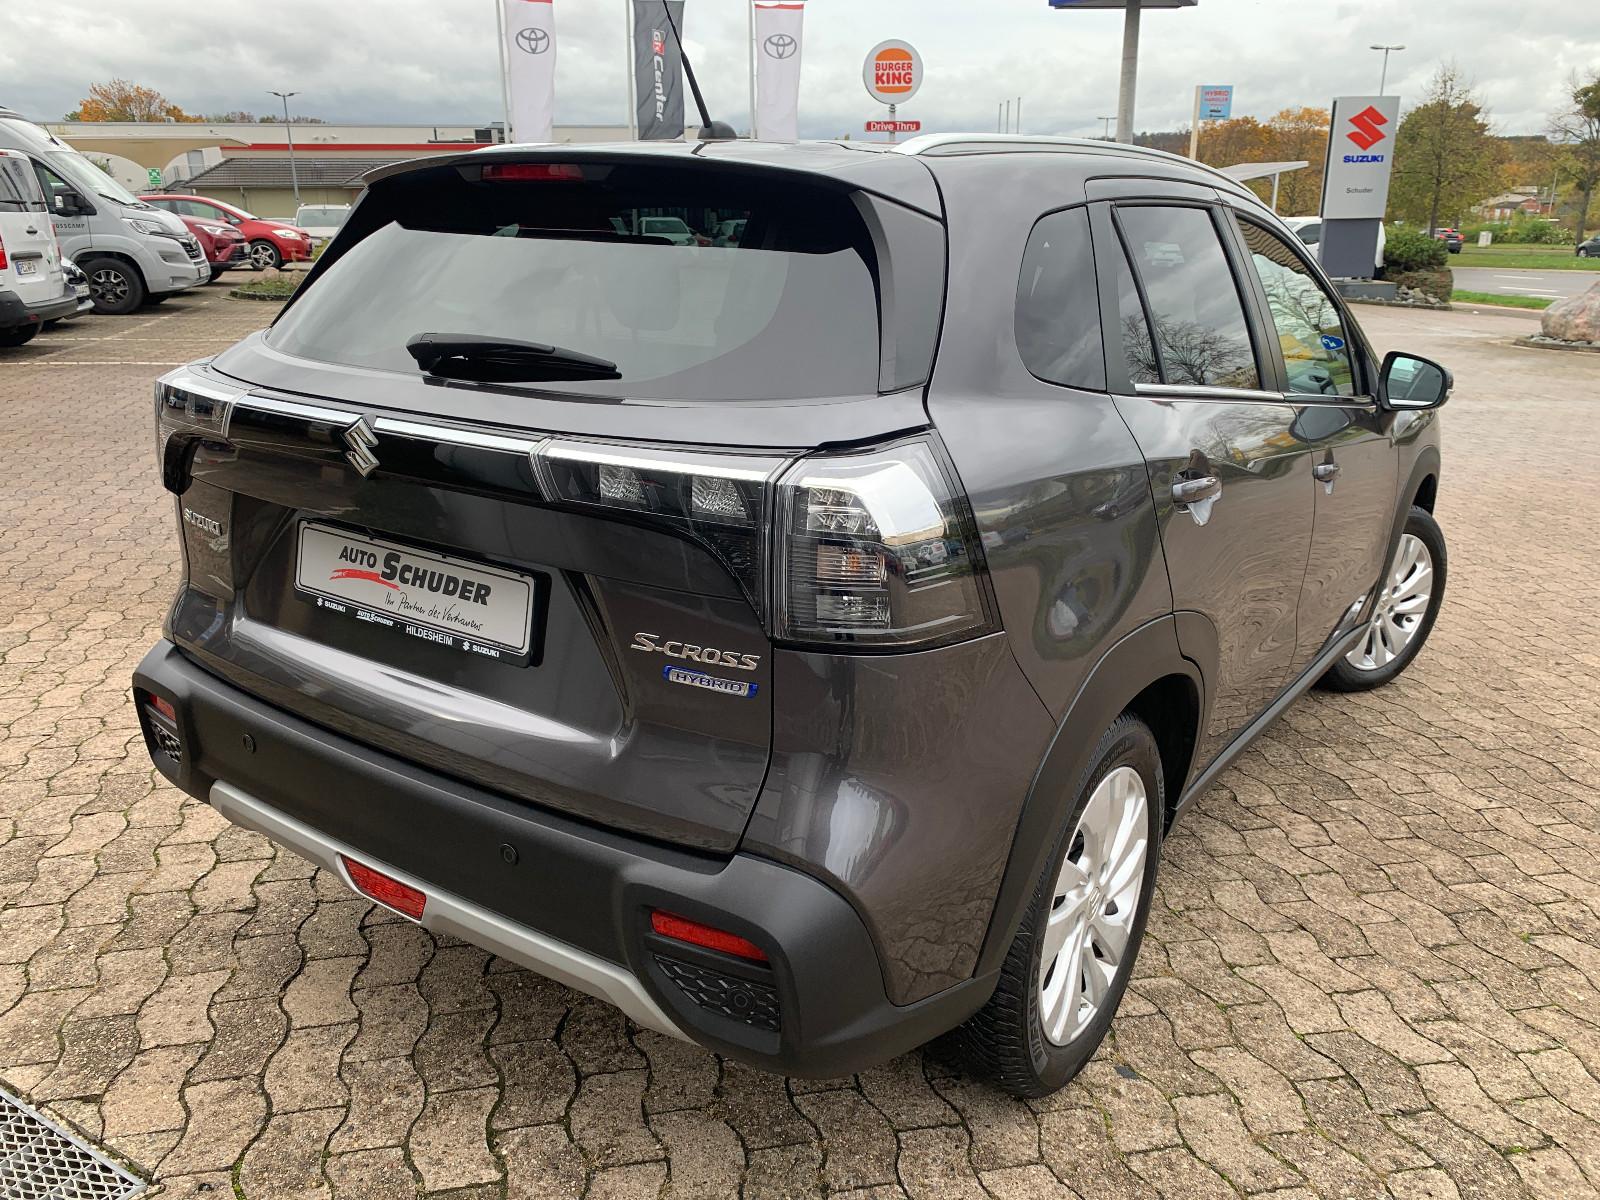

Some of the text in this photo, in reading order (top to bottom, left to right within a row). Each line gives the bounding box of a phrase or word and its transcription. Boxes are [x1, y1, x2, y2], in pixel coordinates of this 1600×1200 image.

[875, 62, 913, 71] BURGER
[875, 72, 913, 85] KING
[653, 55, 667, 122] Center
[870, 121, 916, 131] Drive Thru
[1343, 154, 1384, 163] SUZUKI
[339, 545, 492, 605] AUTO SCHUDER
[324, 600, 346, 613] SUZUKI
[384, 592, 394, 605] Ihr
[398, 592, 426, 614] Partner
[428, 604, 441, 619] des
[405, 624, 453, 645] HILDESHEIM
[472, 644, 500, 657] SUZUKI
[630, 632, 761, 671] S-CROSS
[675, 672, 741, 691] HYBRID
